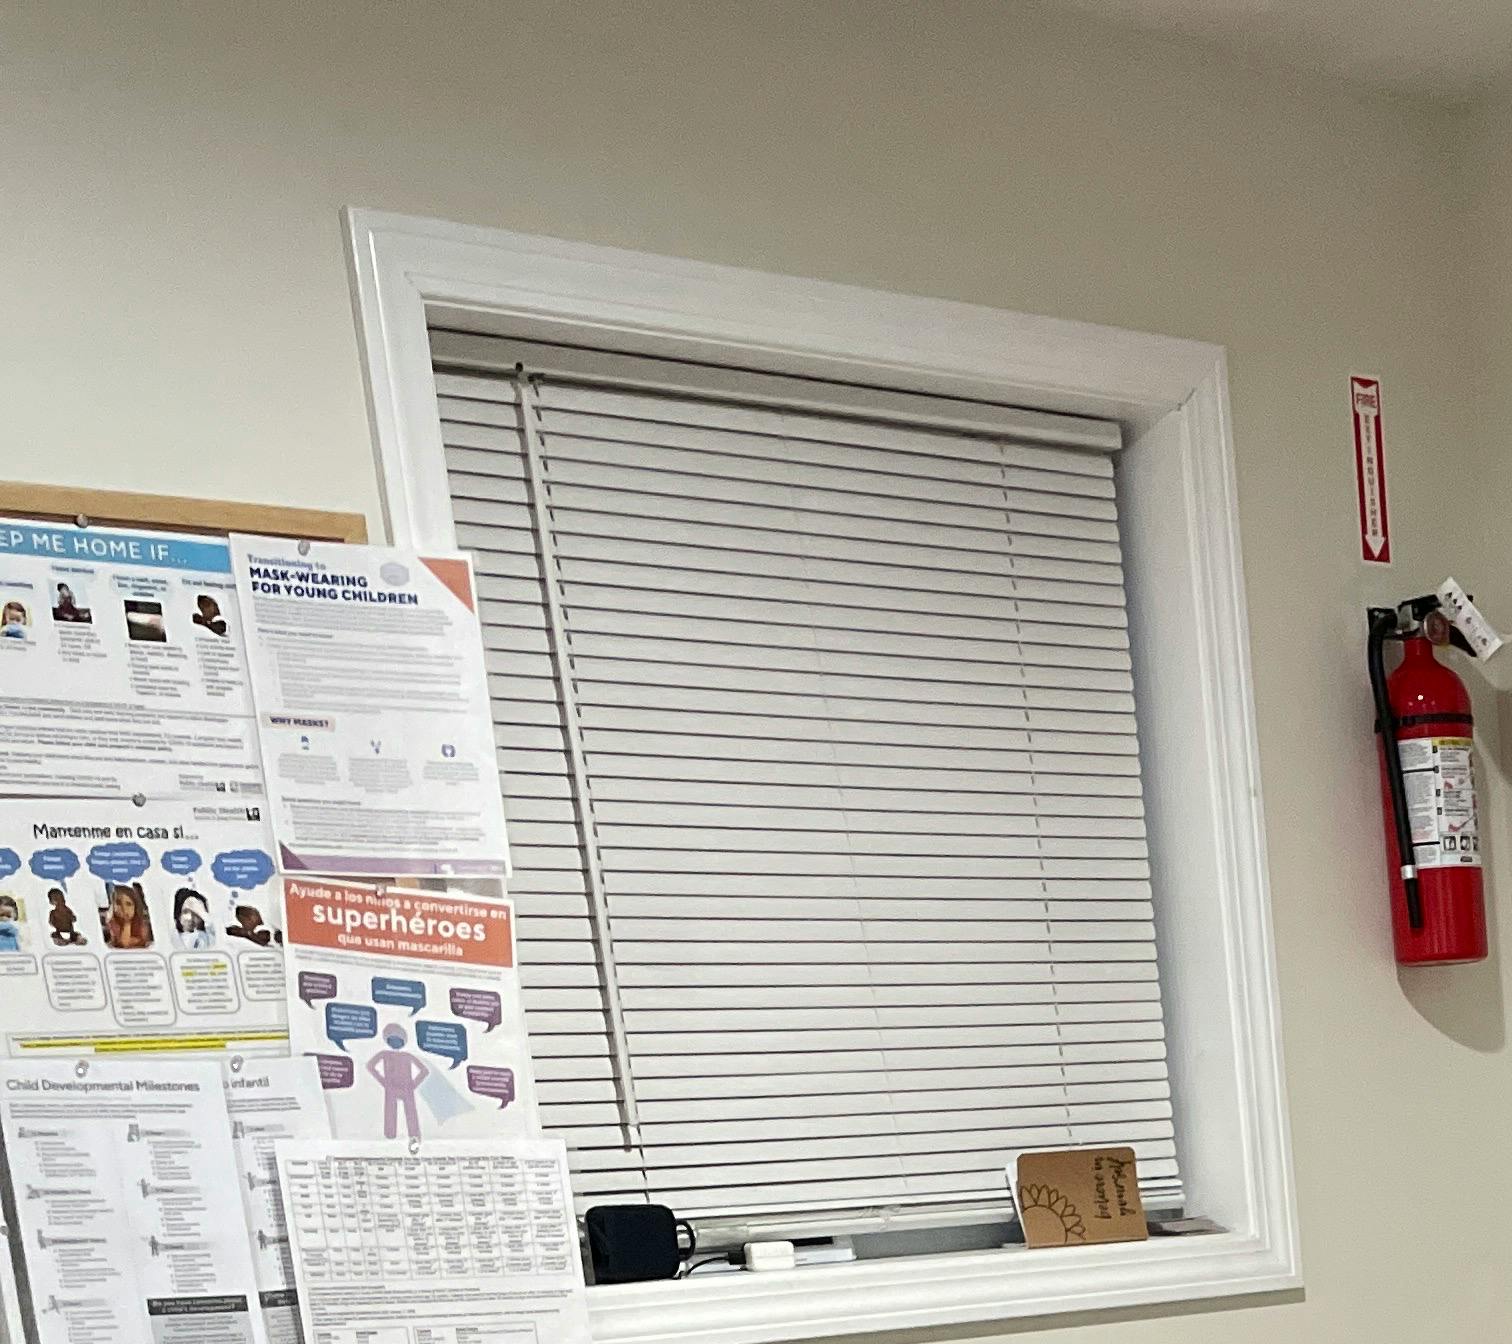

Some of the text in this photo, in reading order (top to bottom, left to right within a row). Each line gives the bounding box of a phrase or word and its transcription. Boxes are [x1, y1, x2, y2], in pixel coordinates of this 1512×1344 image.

[32, 533, 65, 554] ME
[73, 536, 143, 561] HOME
[249, 567, 368, 588] MASK-WEARING
[251, 581, 281, 595] FOR
[285, 585, 338, 601] YOUNG
[342, 589, 418, 606] CHILDREN
[116, 825, 132, 838] en
[137, 826, 169, 839] casa
[312, 904, 486, 942] superhéroes
[337, 933, 463, 957] que usan mascarilla
[7, 1080, 200, 1093] Child Developmental Milestones
